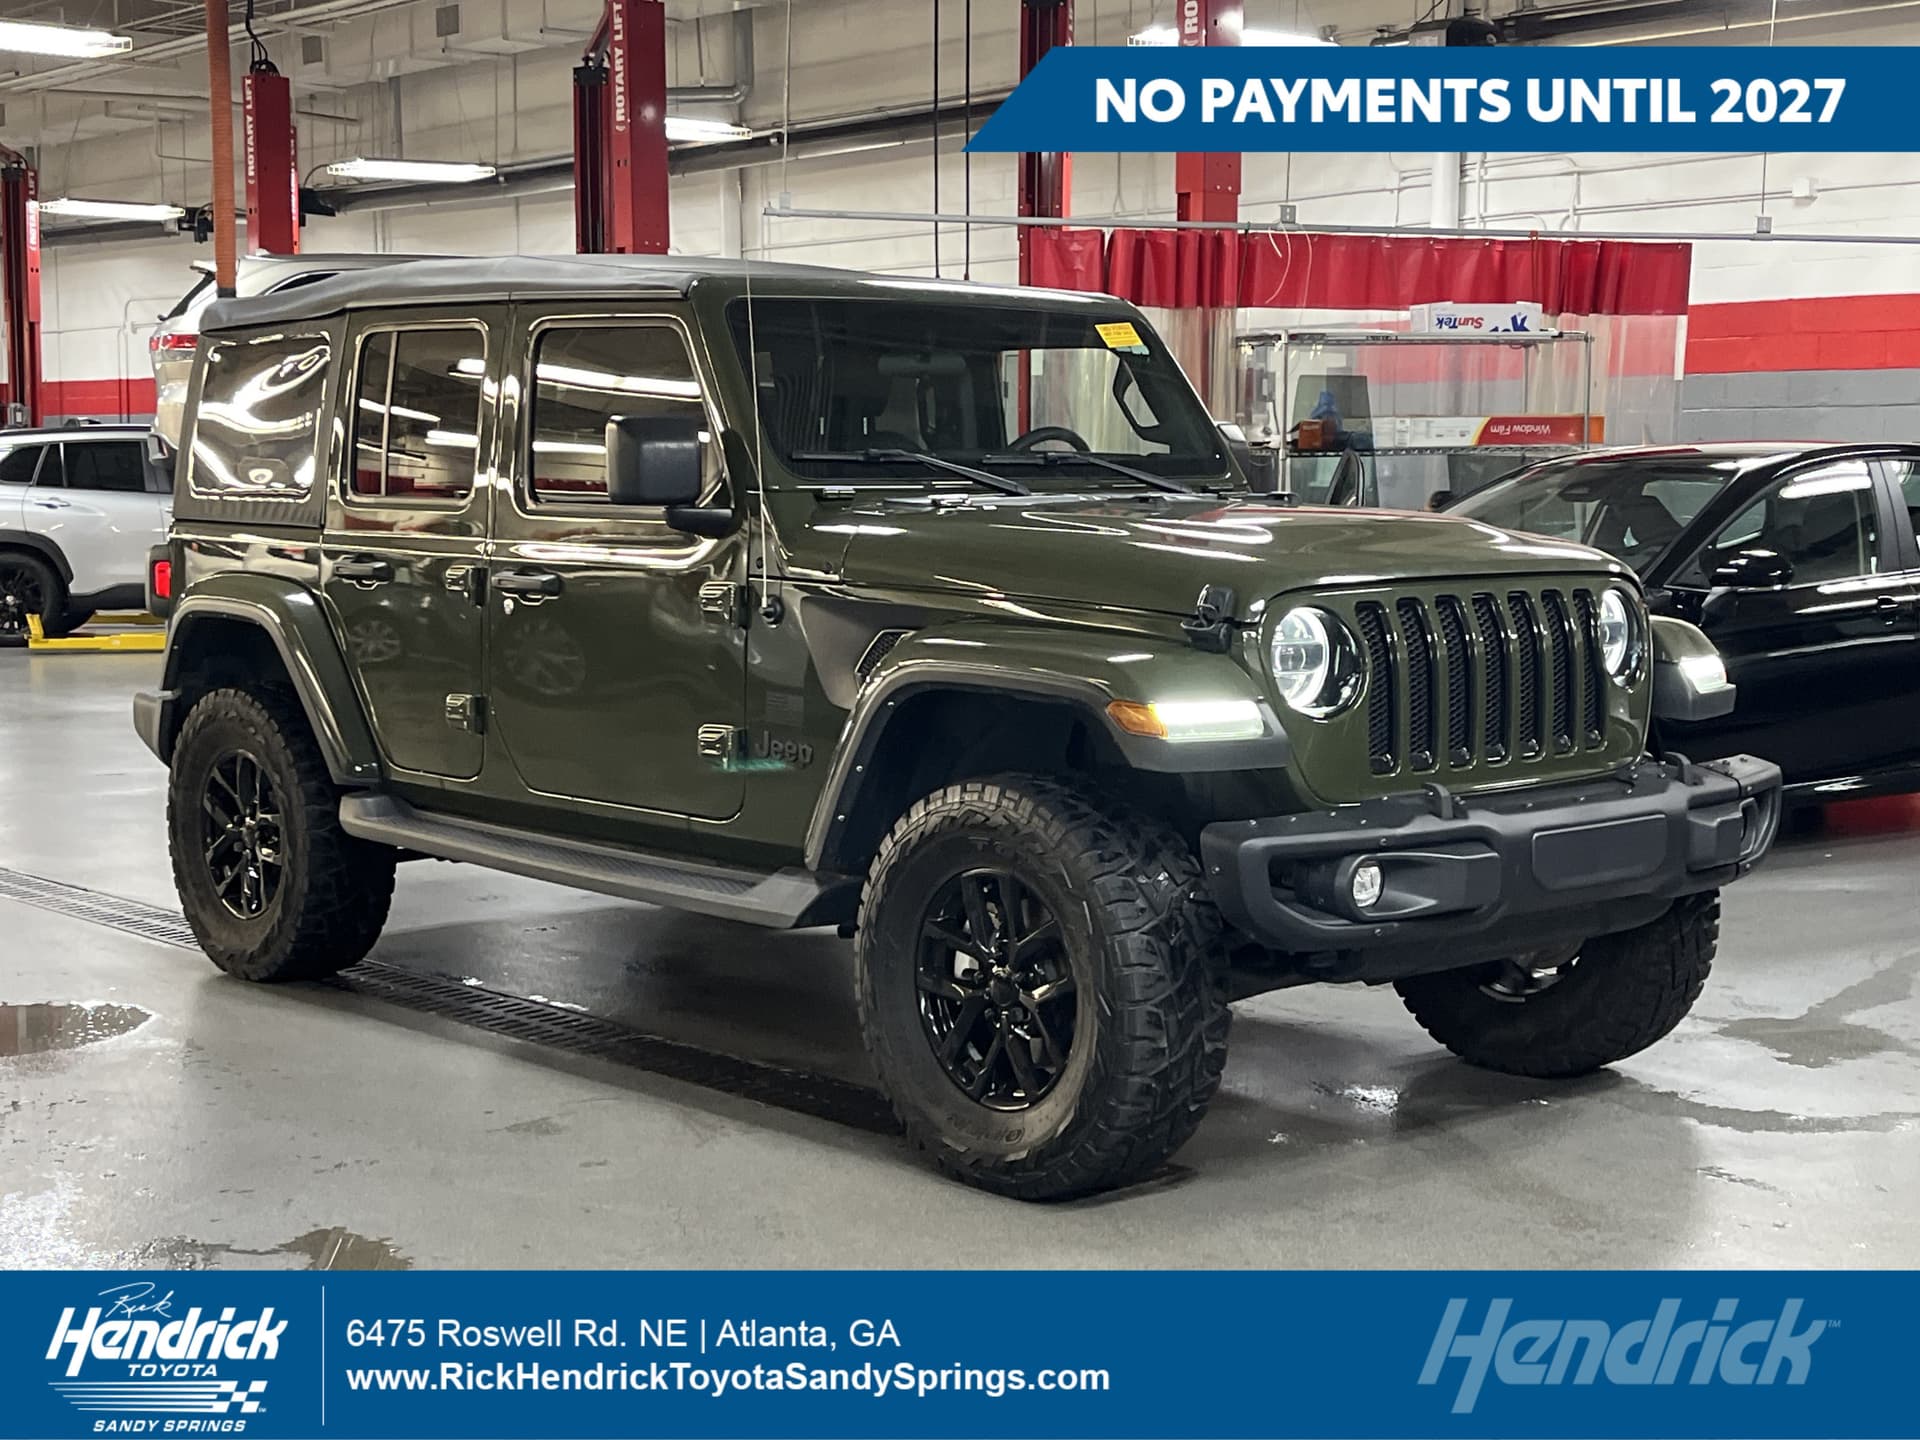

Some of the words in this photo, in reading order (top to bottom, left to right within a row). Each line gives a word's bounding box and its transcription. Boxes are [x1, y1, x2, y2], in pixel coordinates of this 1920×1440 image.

[613, 2, 624, 40] LIFT
[1184, 0, 1198, 34] RO
[244, 77, 254, 110] LIFT
[614, 47, 625, 121] ROTARY
[245, 115, 255, 177] ROTARY
[1435, 316, 1485, 330] SunTek
[1490, 424, 1512, 435] Film
[1512, 424, 1551, 436] Window
[755, 730, 814, 768] Jeep
